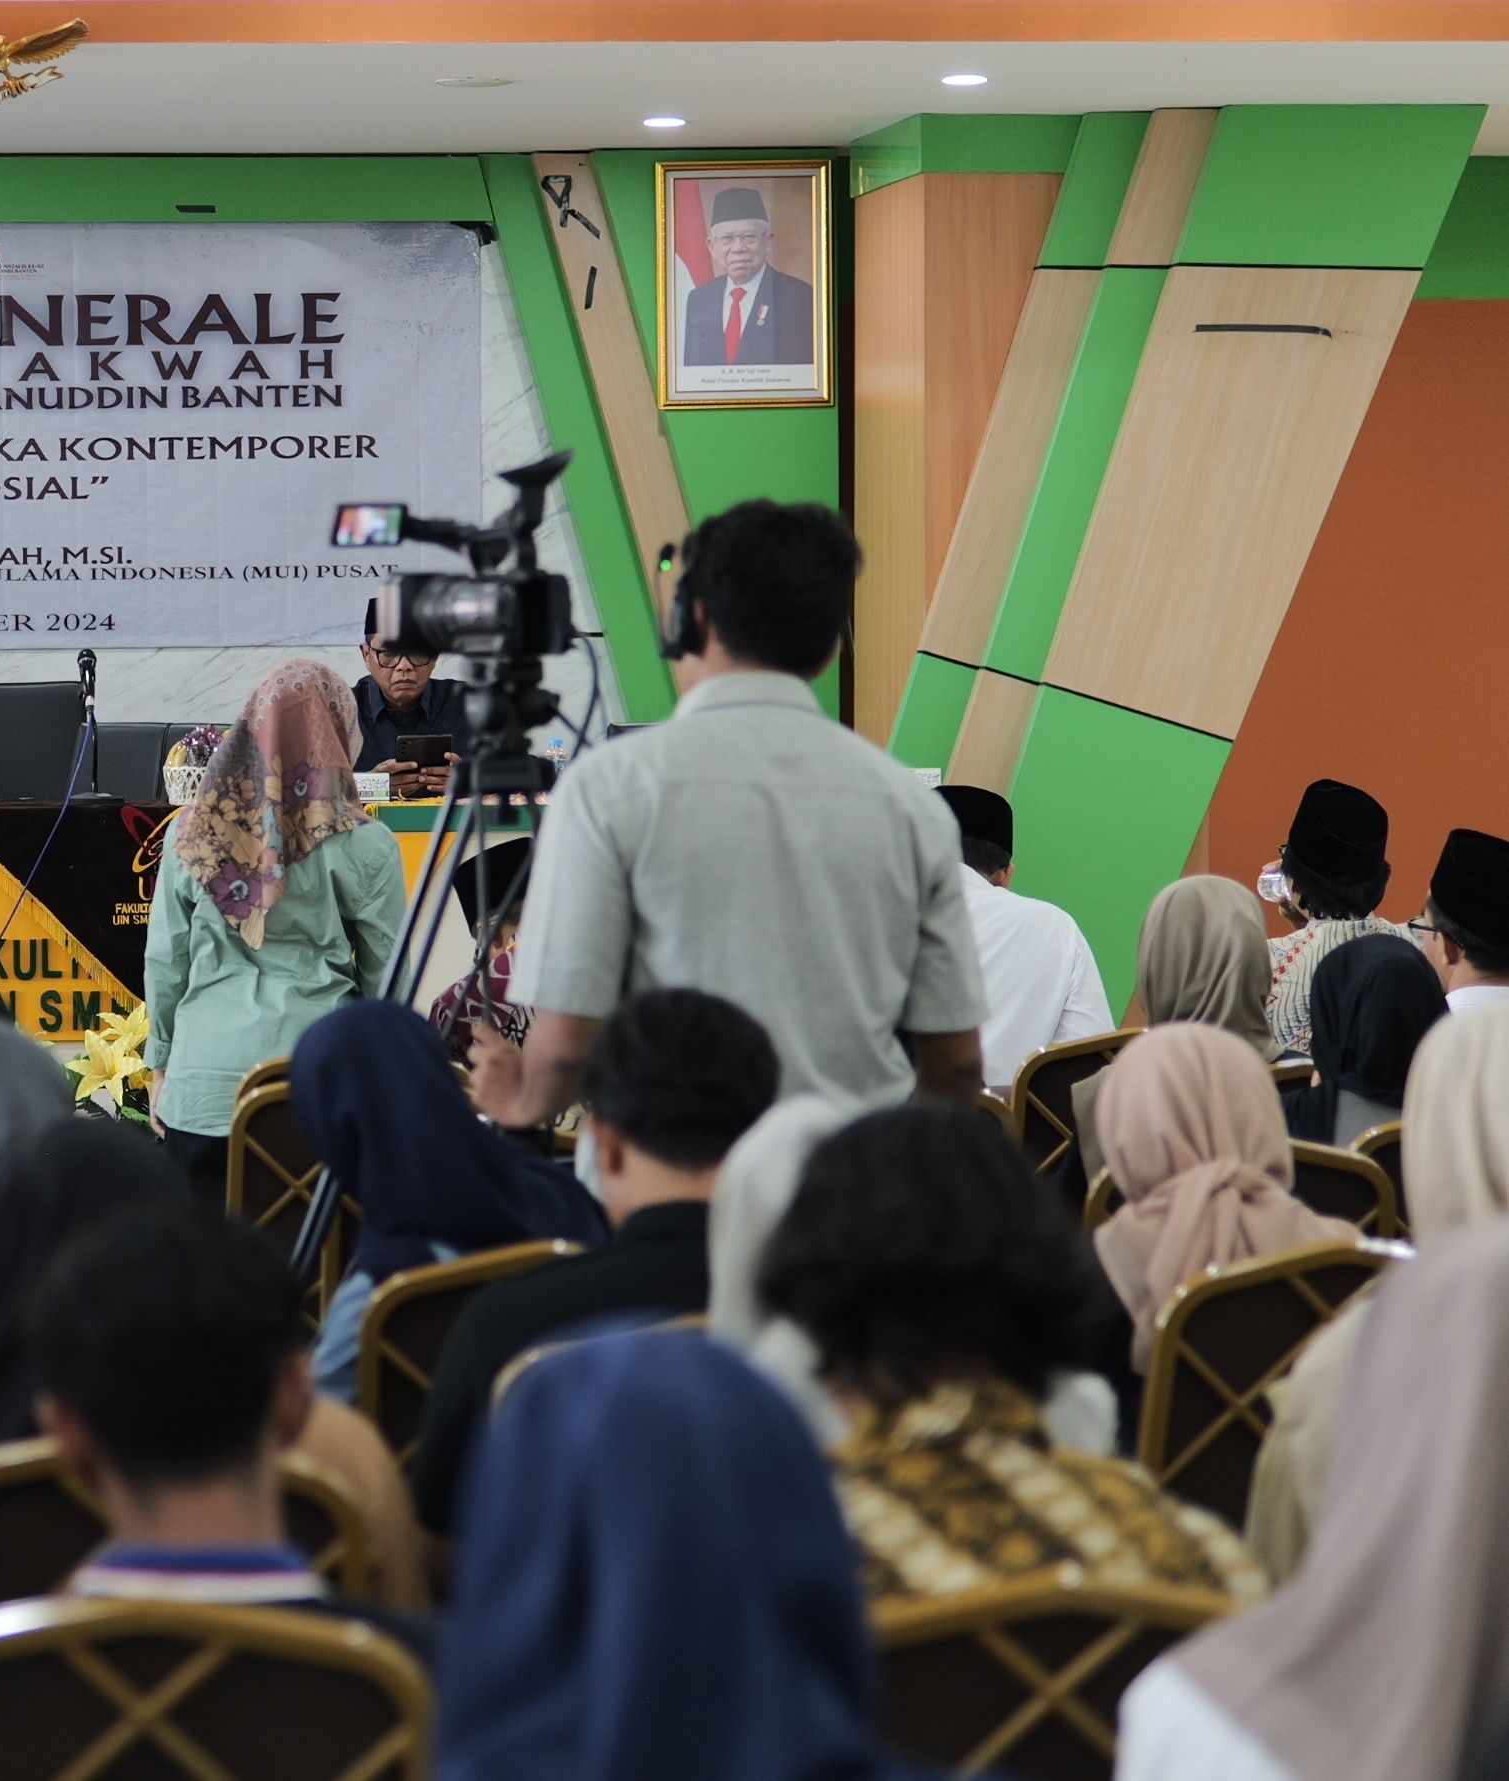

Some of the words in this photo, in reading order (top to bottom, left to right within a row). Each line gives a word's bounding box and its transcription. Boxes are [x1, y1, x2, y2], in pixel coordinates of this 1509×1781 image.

[181, 384, 344, 409] BANTEN
[58, 434, 380, 462] KONTEMPORER
[61, 546, 134, 566] M.SI.
[90, 566, 236, 581] INDONESIA
[242, 563, 309, 582] (MUI)
[316, 563, 399, 580] PUSAT
[46, 613, 117, 632] 2024
[115, 902, 152, 915] FAKULT
[112, 914, 130, 925] UIN
